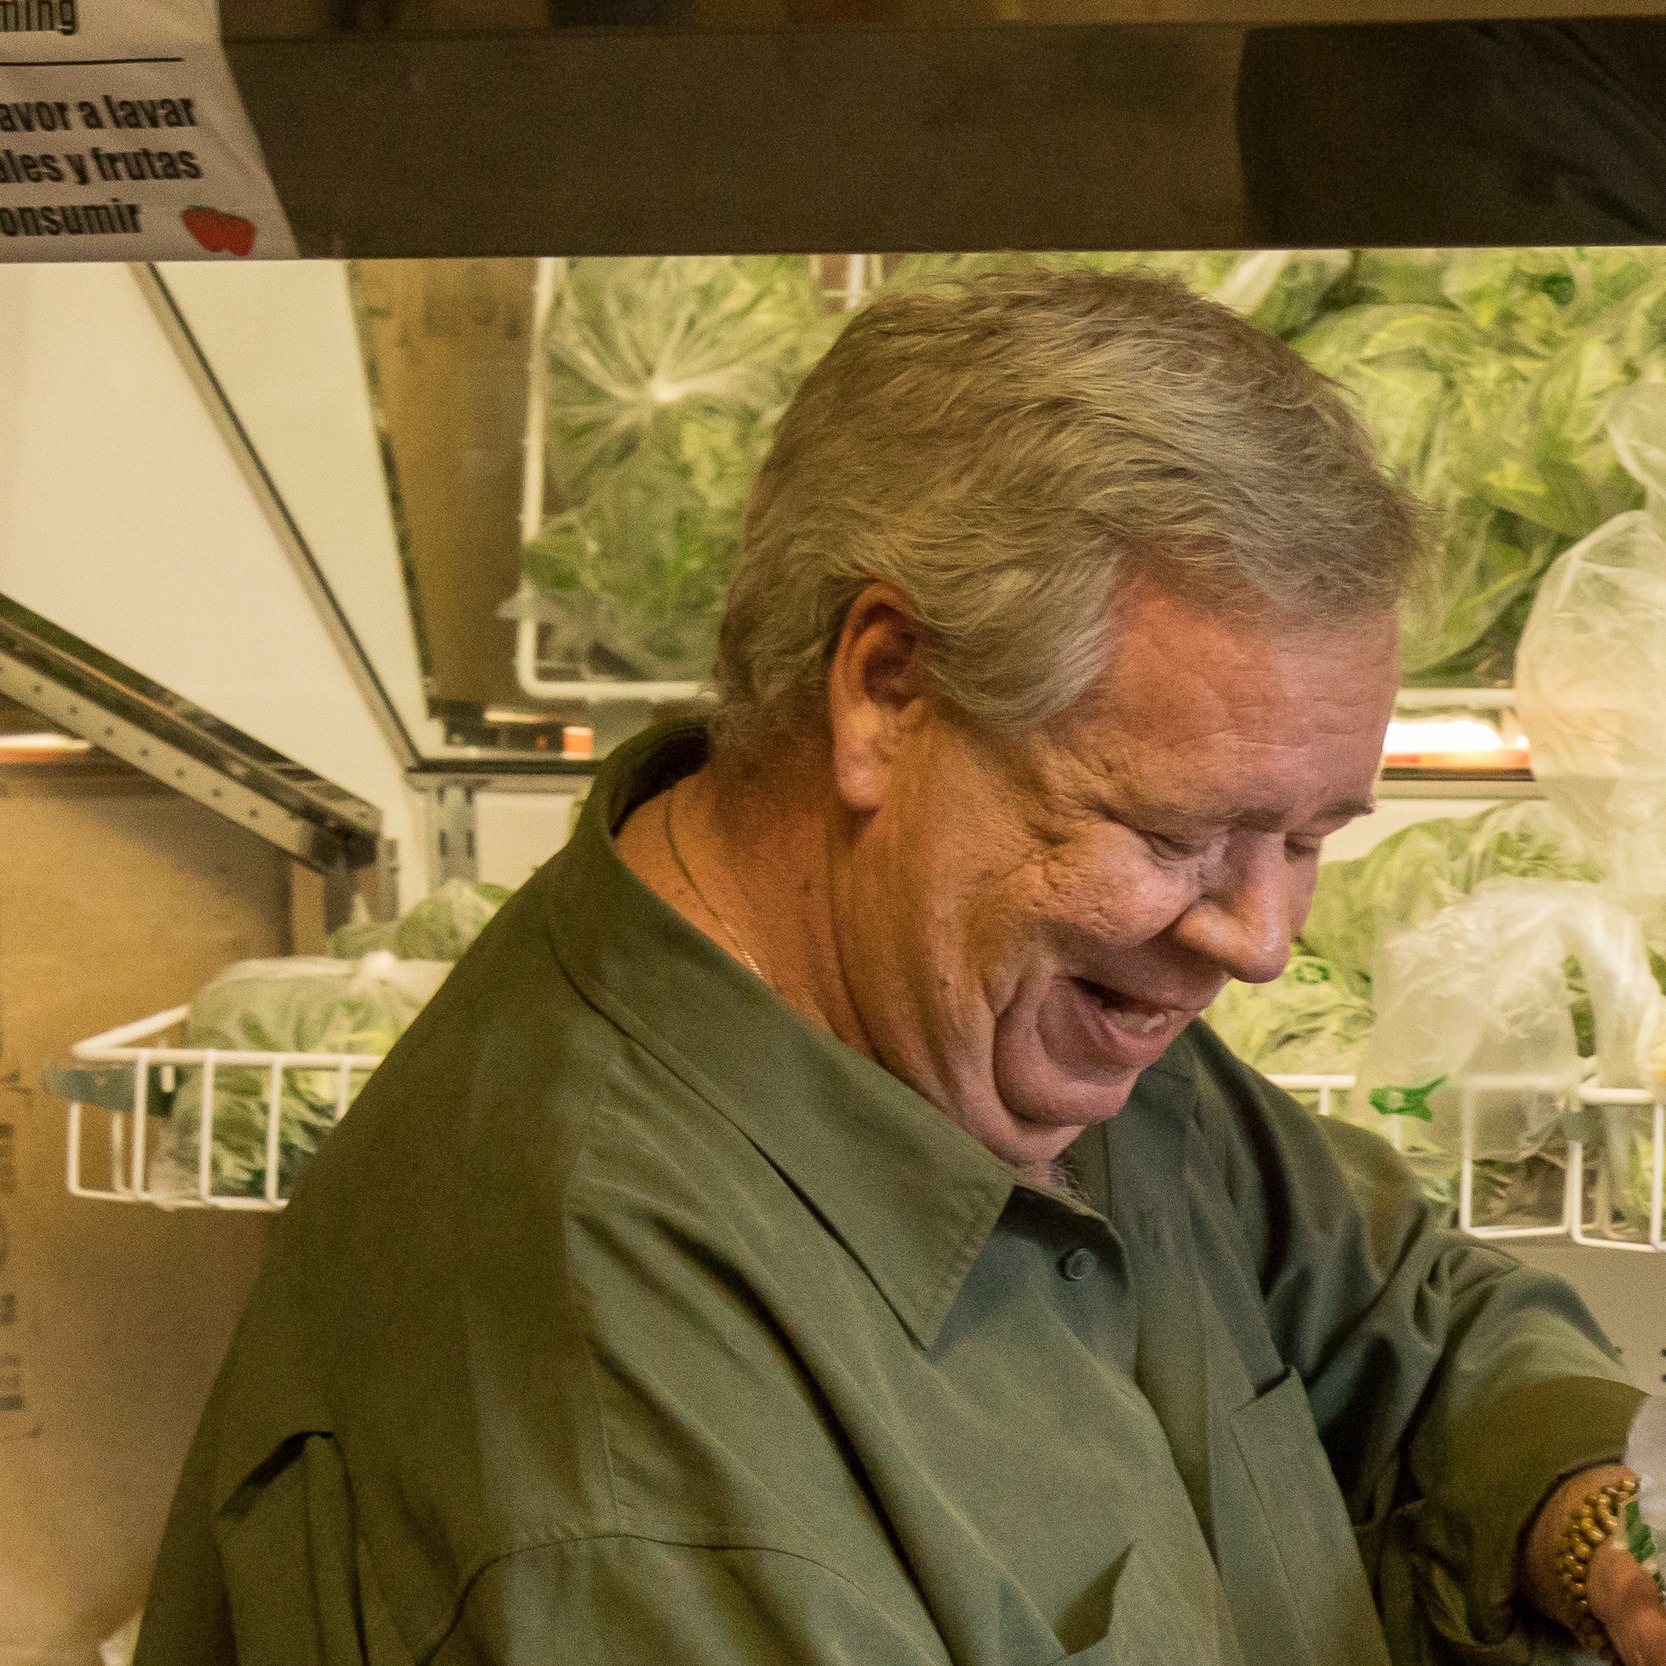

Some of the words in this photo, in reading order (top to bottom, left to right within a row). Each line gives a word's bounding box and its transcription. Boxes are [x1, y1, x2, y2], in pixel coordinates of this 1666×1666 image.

[77, 100, 104, 130] a
[104, 95, 198, 129] lavar
[64, 153, 90, 186] y
[89, 148, 203, 182] frutas
